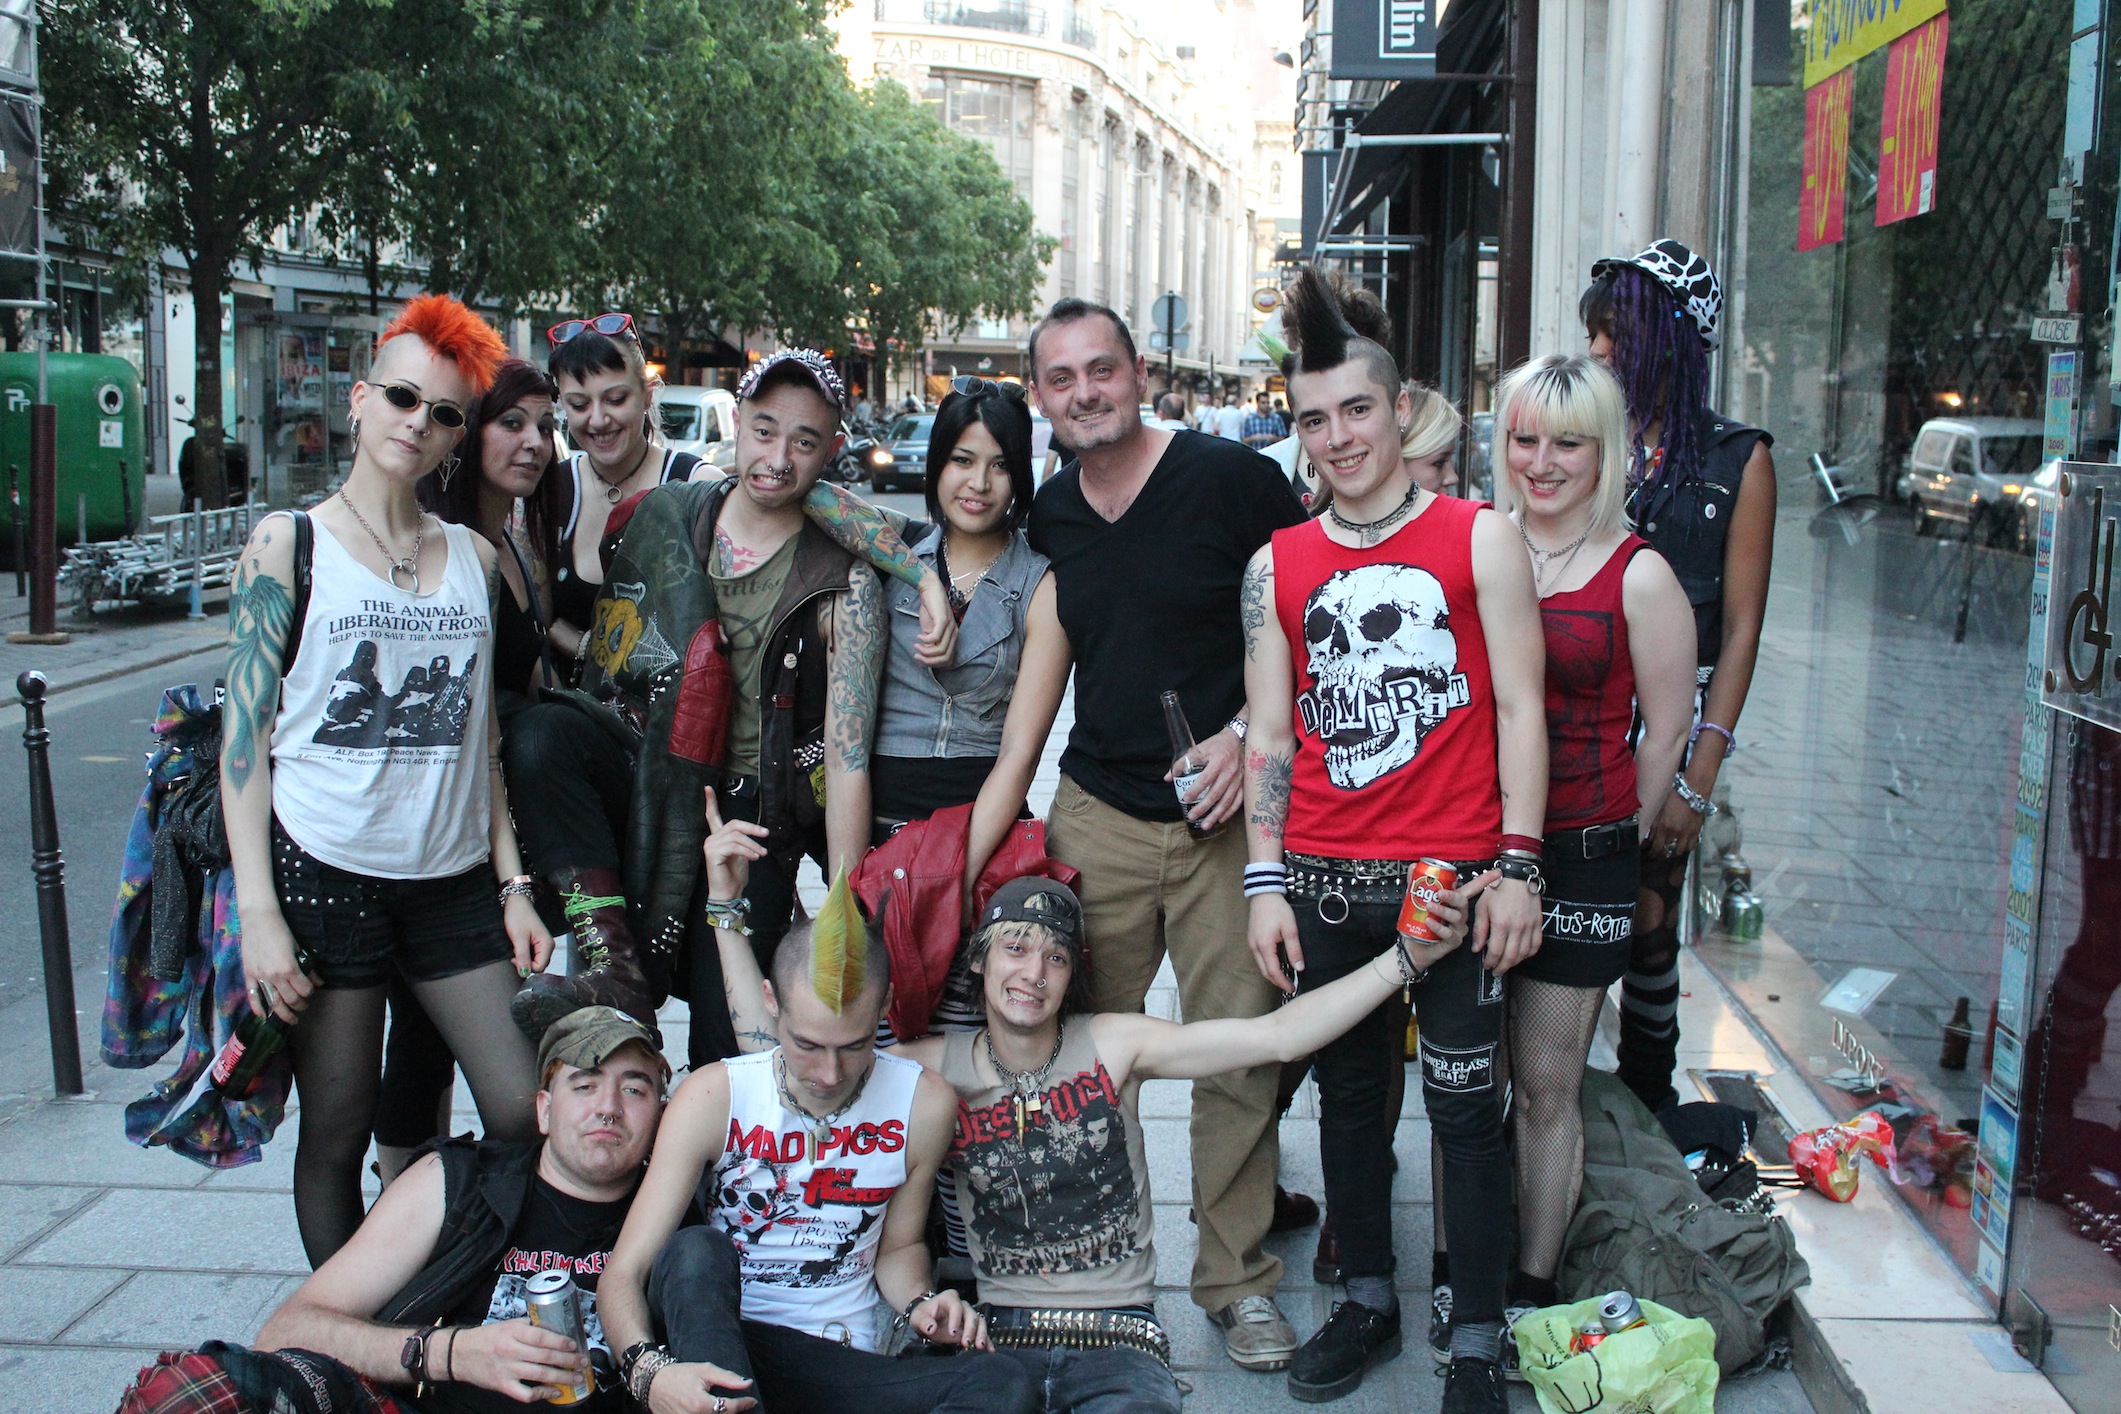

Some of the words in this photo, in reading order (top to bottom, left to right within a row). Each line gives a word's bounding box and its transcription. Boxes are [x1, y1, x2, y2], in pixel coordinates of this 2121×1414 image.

[1390, 0, 1425, 49] lin
[2037, 319, 2072, 342] CLOSE
[282, 364, 321, 379] IBIZA
[360, 599, 396, 614] THE
[400, 604, 468, 618] ANIMAL
[329, 614, 433, 635] LIBERATION
[438, 615, 488, 631] FRONT
[328, 632, 351, 645] HELP
[354, 630, 367, 639] US
[370, 630, 382, 638] TO
[384, 631, 406, 641] SAVE
[408, 633, 427, 642] THE
[429, 631, 469, 642] ANIMALS
[1410, 879, 1441, 903] Lage
[2005, 919, 2029, 956] PARIS
[1422, 1050, 1449, 1071] LOWER
[1451, 1057, 1490, 1071] CLASS
[725, 1117, 805, 1164] MAD
[816, 1119, 906, 1161] PIGS
